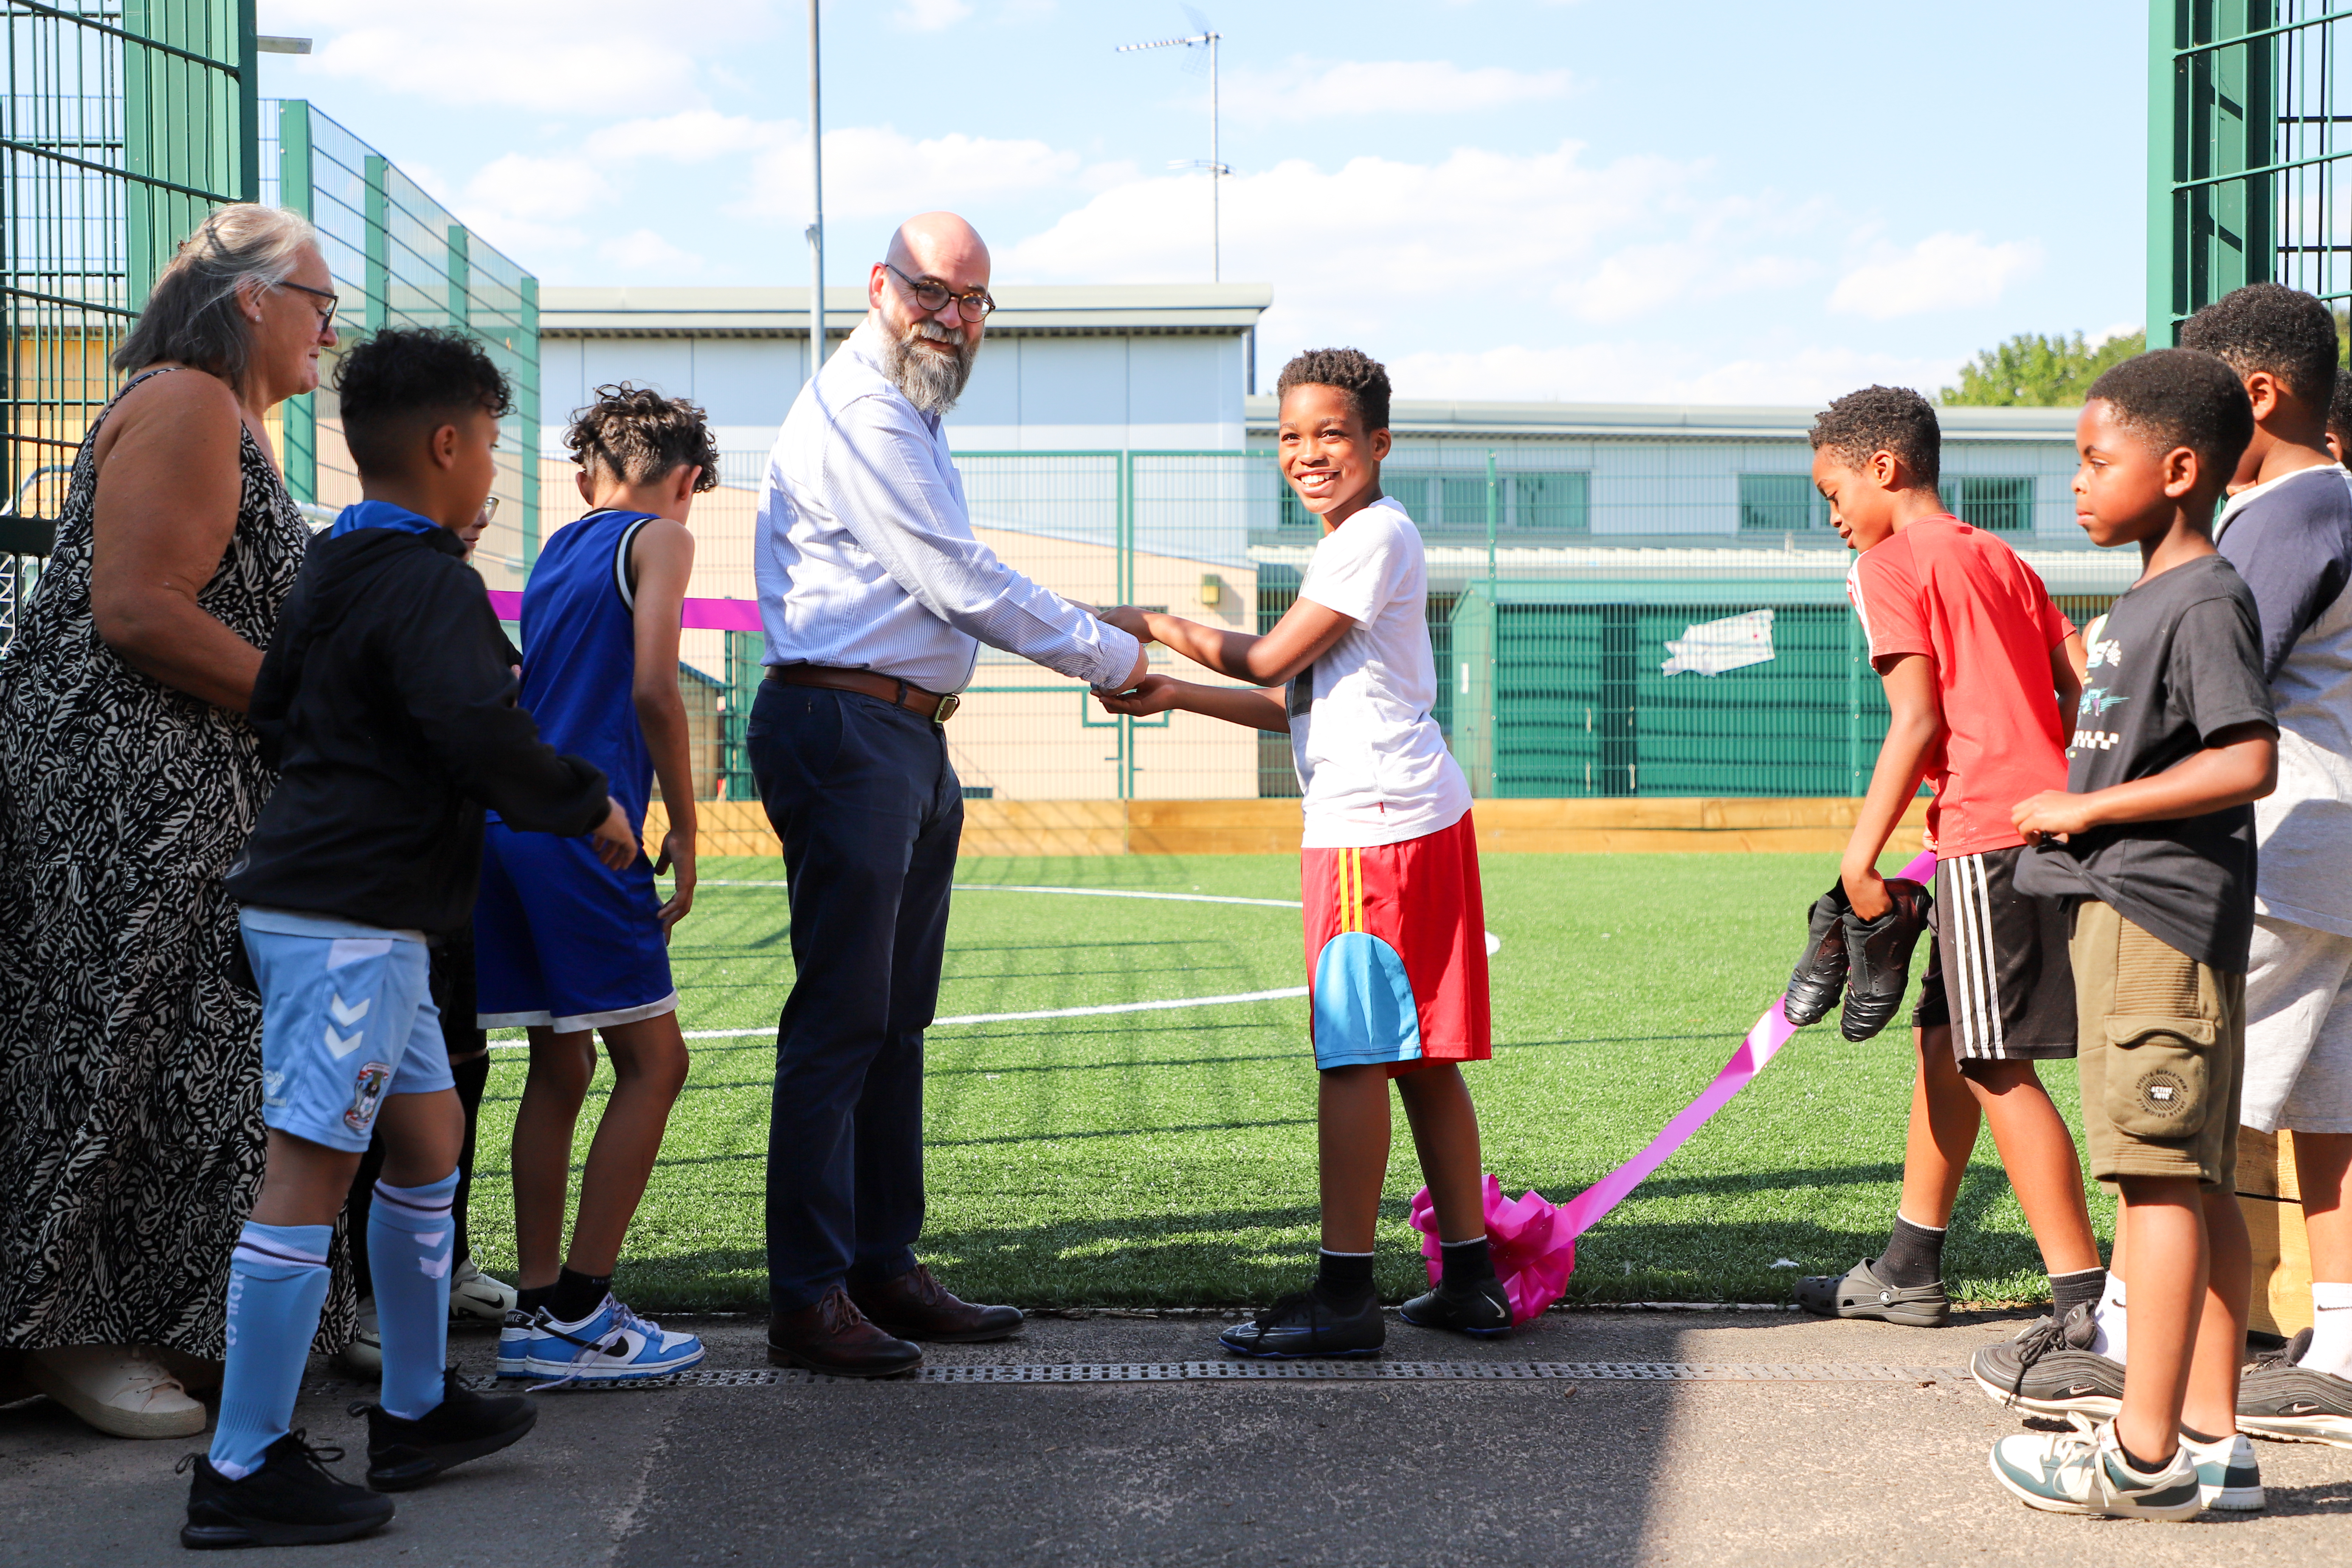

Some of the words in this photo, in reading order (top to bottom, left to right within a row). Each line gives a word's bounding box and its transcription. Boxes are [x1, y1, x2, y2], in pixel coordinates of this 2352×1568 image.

[2136, 1072, 2154, 1089] SPORTS
[2151, 1086, 2173, 1094] ACTIVE
[504, 1313, 522, 1322] NIKE
